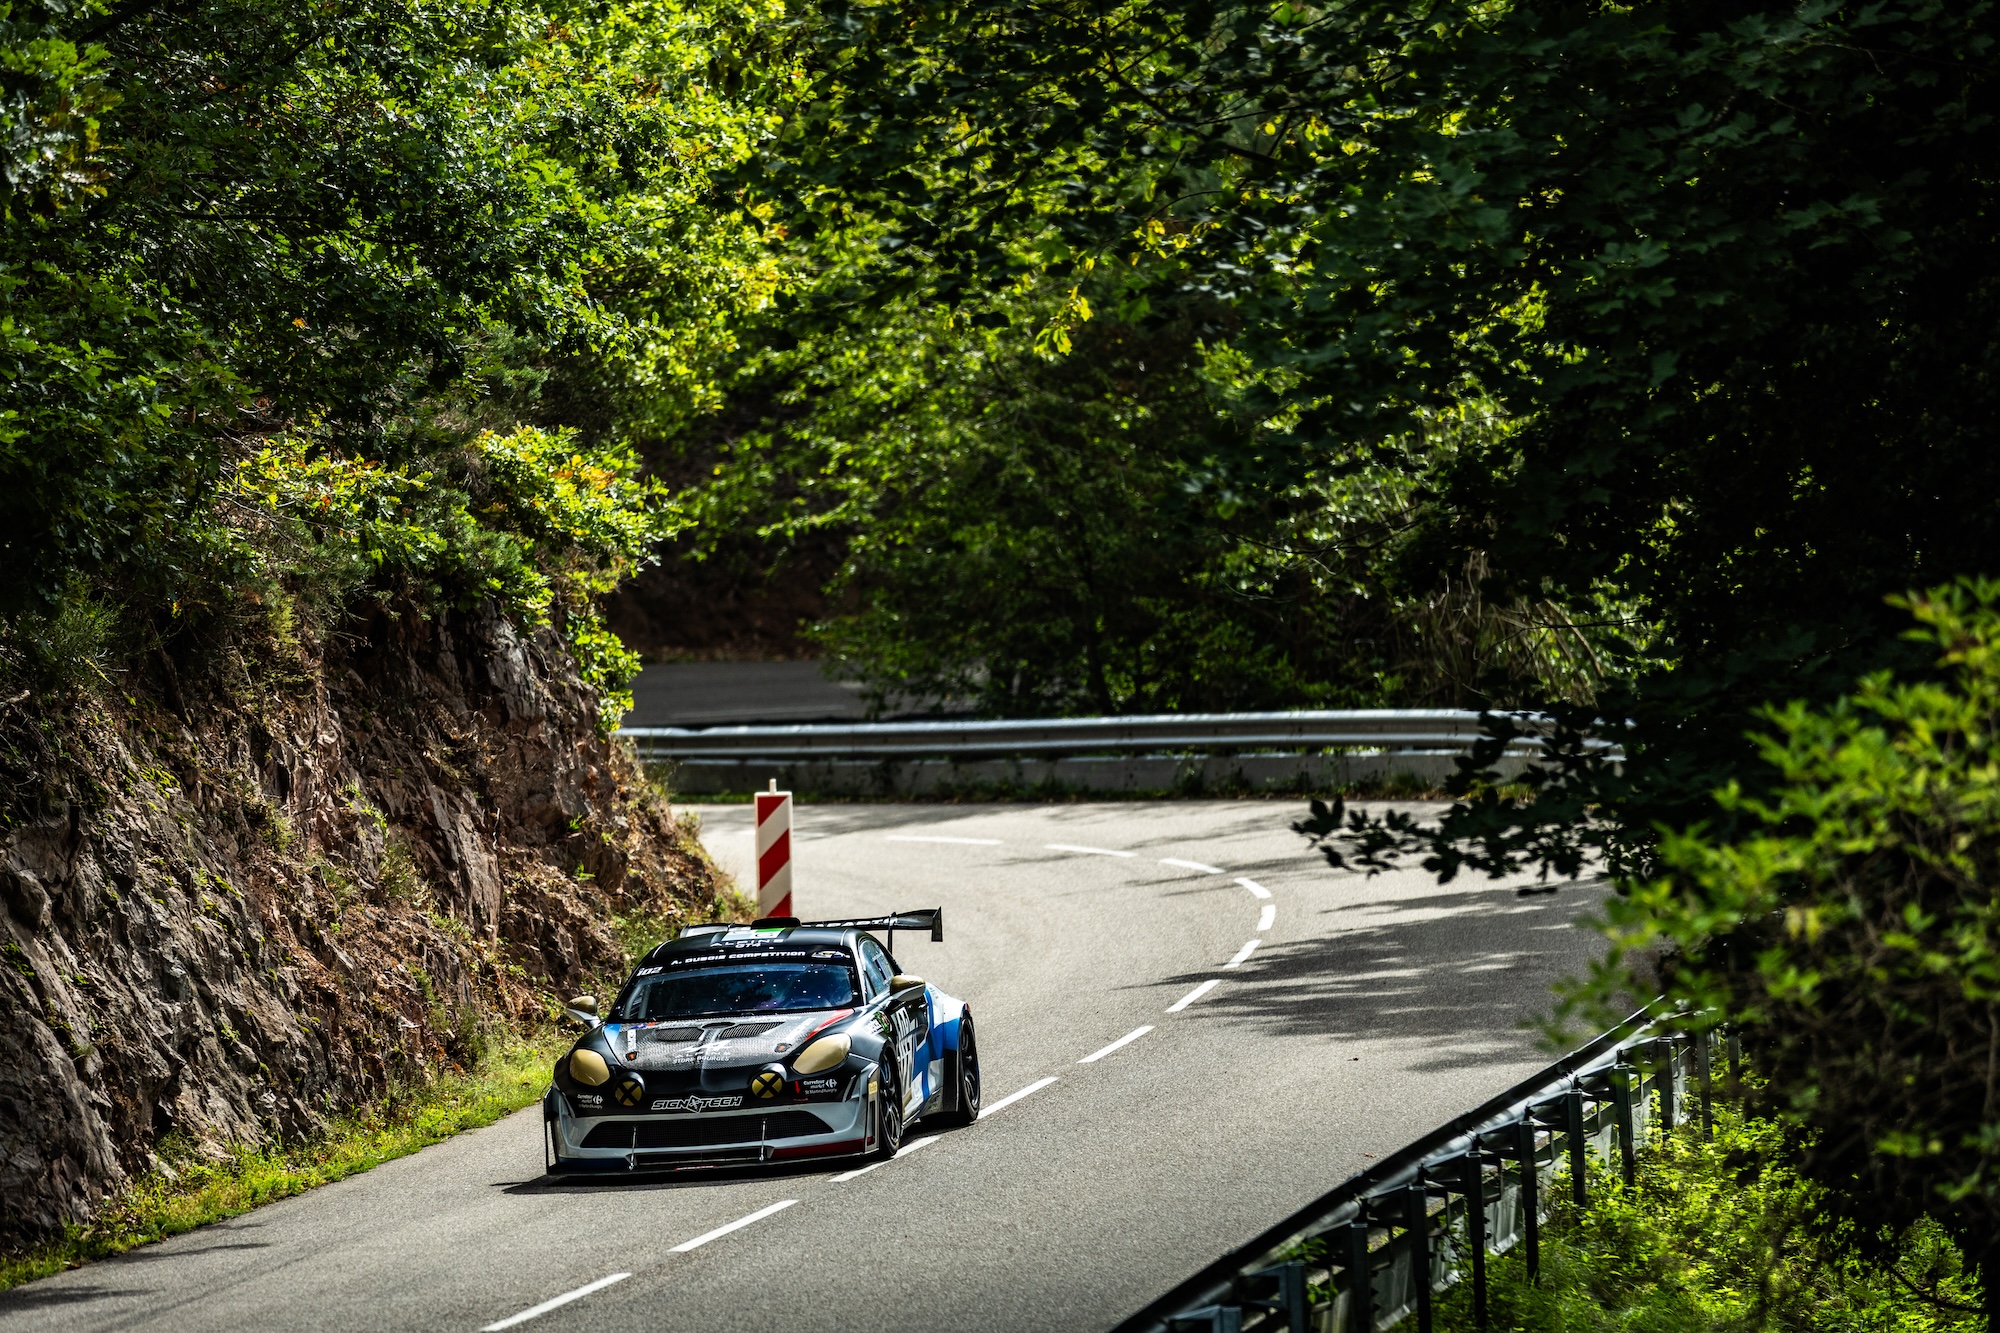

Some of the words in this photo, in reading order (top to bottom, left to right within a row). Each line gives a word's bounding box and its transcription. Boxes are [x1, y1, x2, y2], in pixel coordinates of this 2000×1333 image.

[728, 951, 806, 959] COMPETITION
[651, 1099, 689, 1110] SIGN
[699, 1096, 744, 1109] TECH
